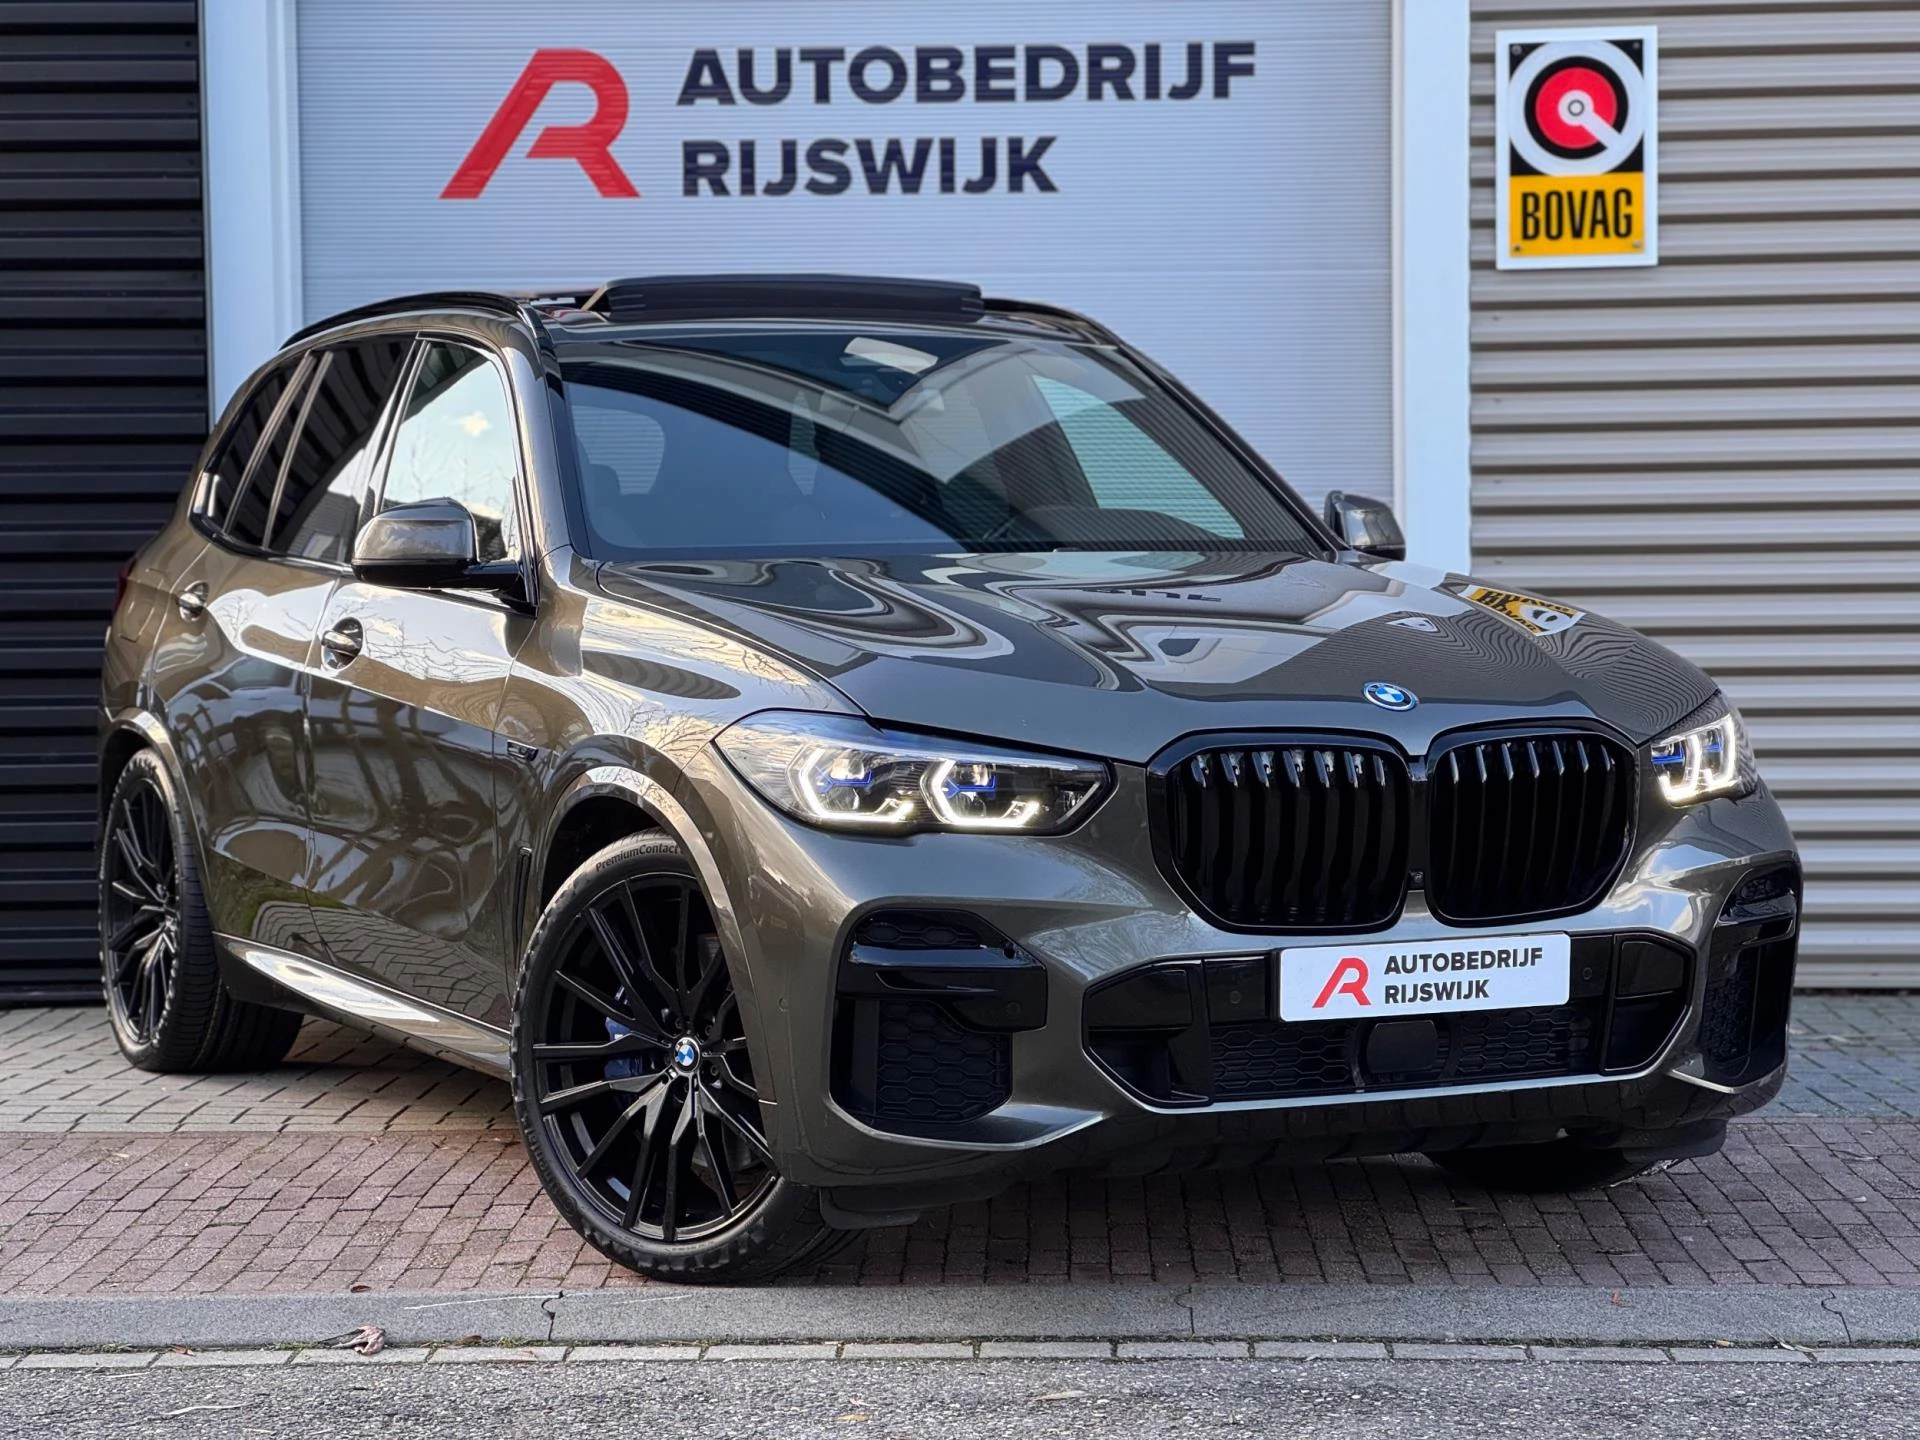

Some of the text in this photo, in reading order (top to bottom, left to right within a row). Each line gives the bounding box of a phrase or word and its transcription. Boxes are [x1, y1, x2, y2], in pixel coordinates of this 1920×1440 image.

[677, 42, 1255, 105] AUTOBEDRIJF
[683, 137, 1057, 196] RIJSWIJK
[1521, 188, 1633, 241] BOVAG
[595, 842, 678, 872] PremiumContact
[1384, 947, 1543, 975] AUTOBEDRIJF
[1385, 979, 1490, 1004] RIJSWIJK
